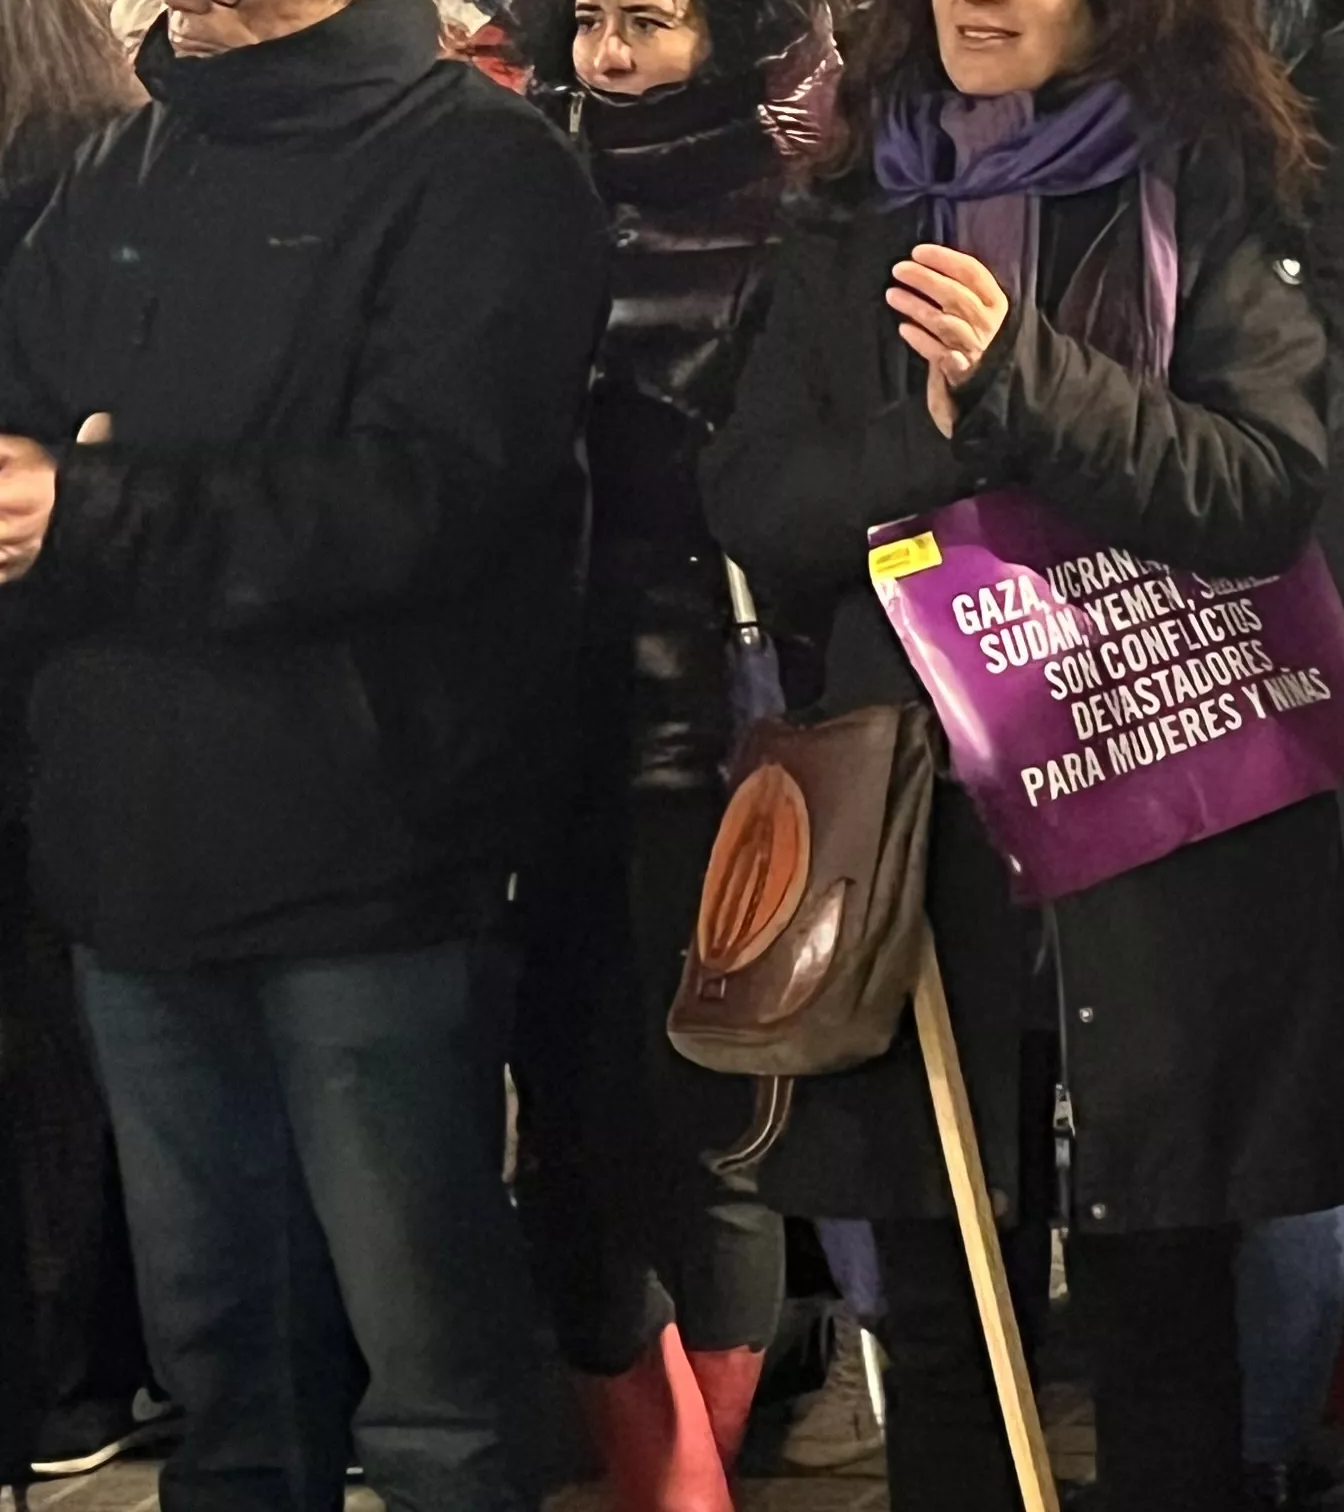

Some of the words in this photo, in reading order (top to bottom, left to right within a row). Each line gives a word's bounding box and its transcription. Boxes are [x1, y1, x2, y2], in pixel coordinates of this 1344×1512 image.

[951, 574, 1051, 636] GAZA,
[1043, 648, 1103, 701] SON
[1100, 597, 1263, 680] CONFLICTOS
[1083, 575, 1197, 636] YEMEN,
[1020, 746, 1106, 808] PARA
[1106, 691, 1243, 775] MUJERES
[1240, 682, 1267, 719] Y
[1263, 666, 1332, 712] NIÑAS
[1070, 639, 1275, 741] DEVASTADORES
